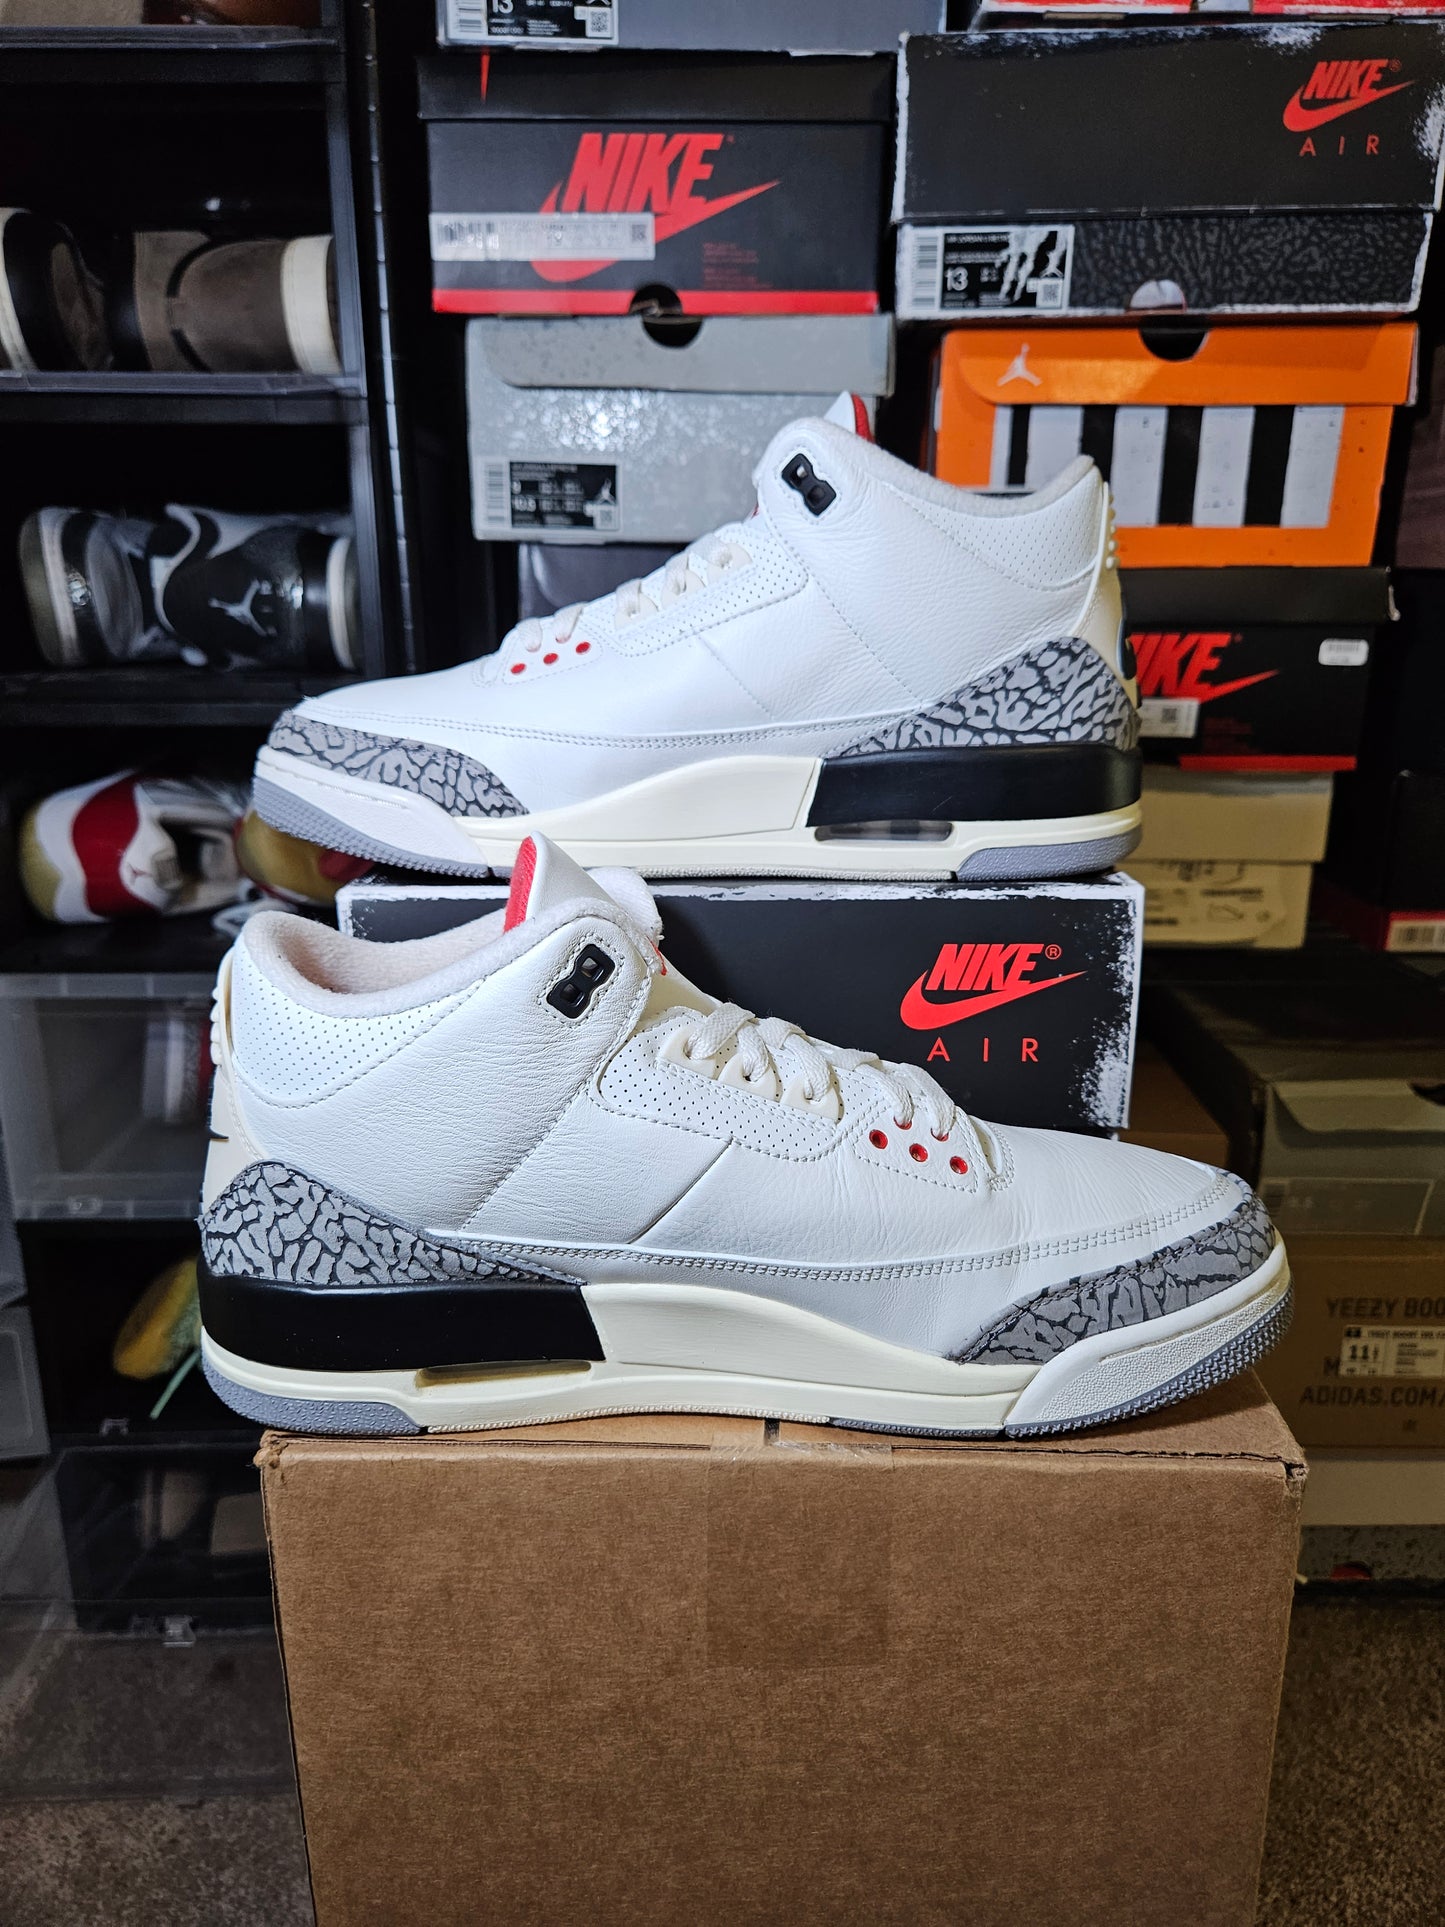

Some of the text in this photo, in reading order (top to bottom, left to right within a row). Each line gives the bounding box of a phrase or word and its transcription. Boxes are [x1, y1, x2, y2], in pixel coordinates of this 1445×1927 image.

[1303, 59, 1389, 100] NIKE
[561, 132, 724, 214] NIKE
[945, 266, 969, 291] 13
[1130, 632, 1232, 697] IKE
[925, 943, 1045, 991] NIKE
[926, 1036, 1040, 1063] AIR
[1326, 1297, 1399, 1318] YEEZY
